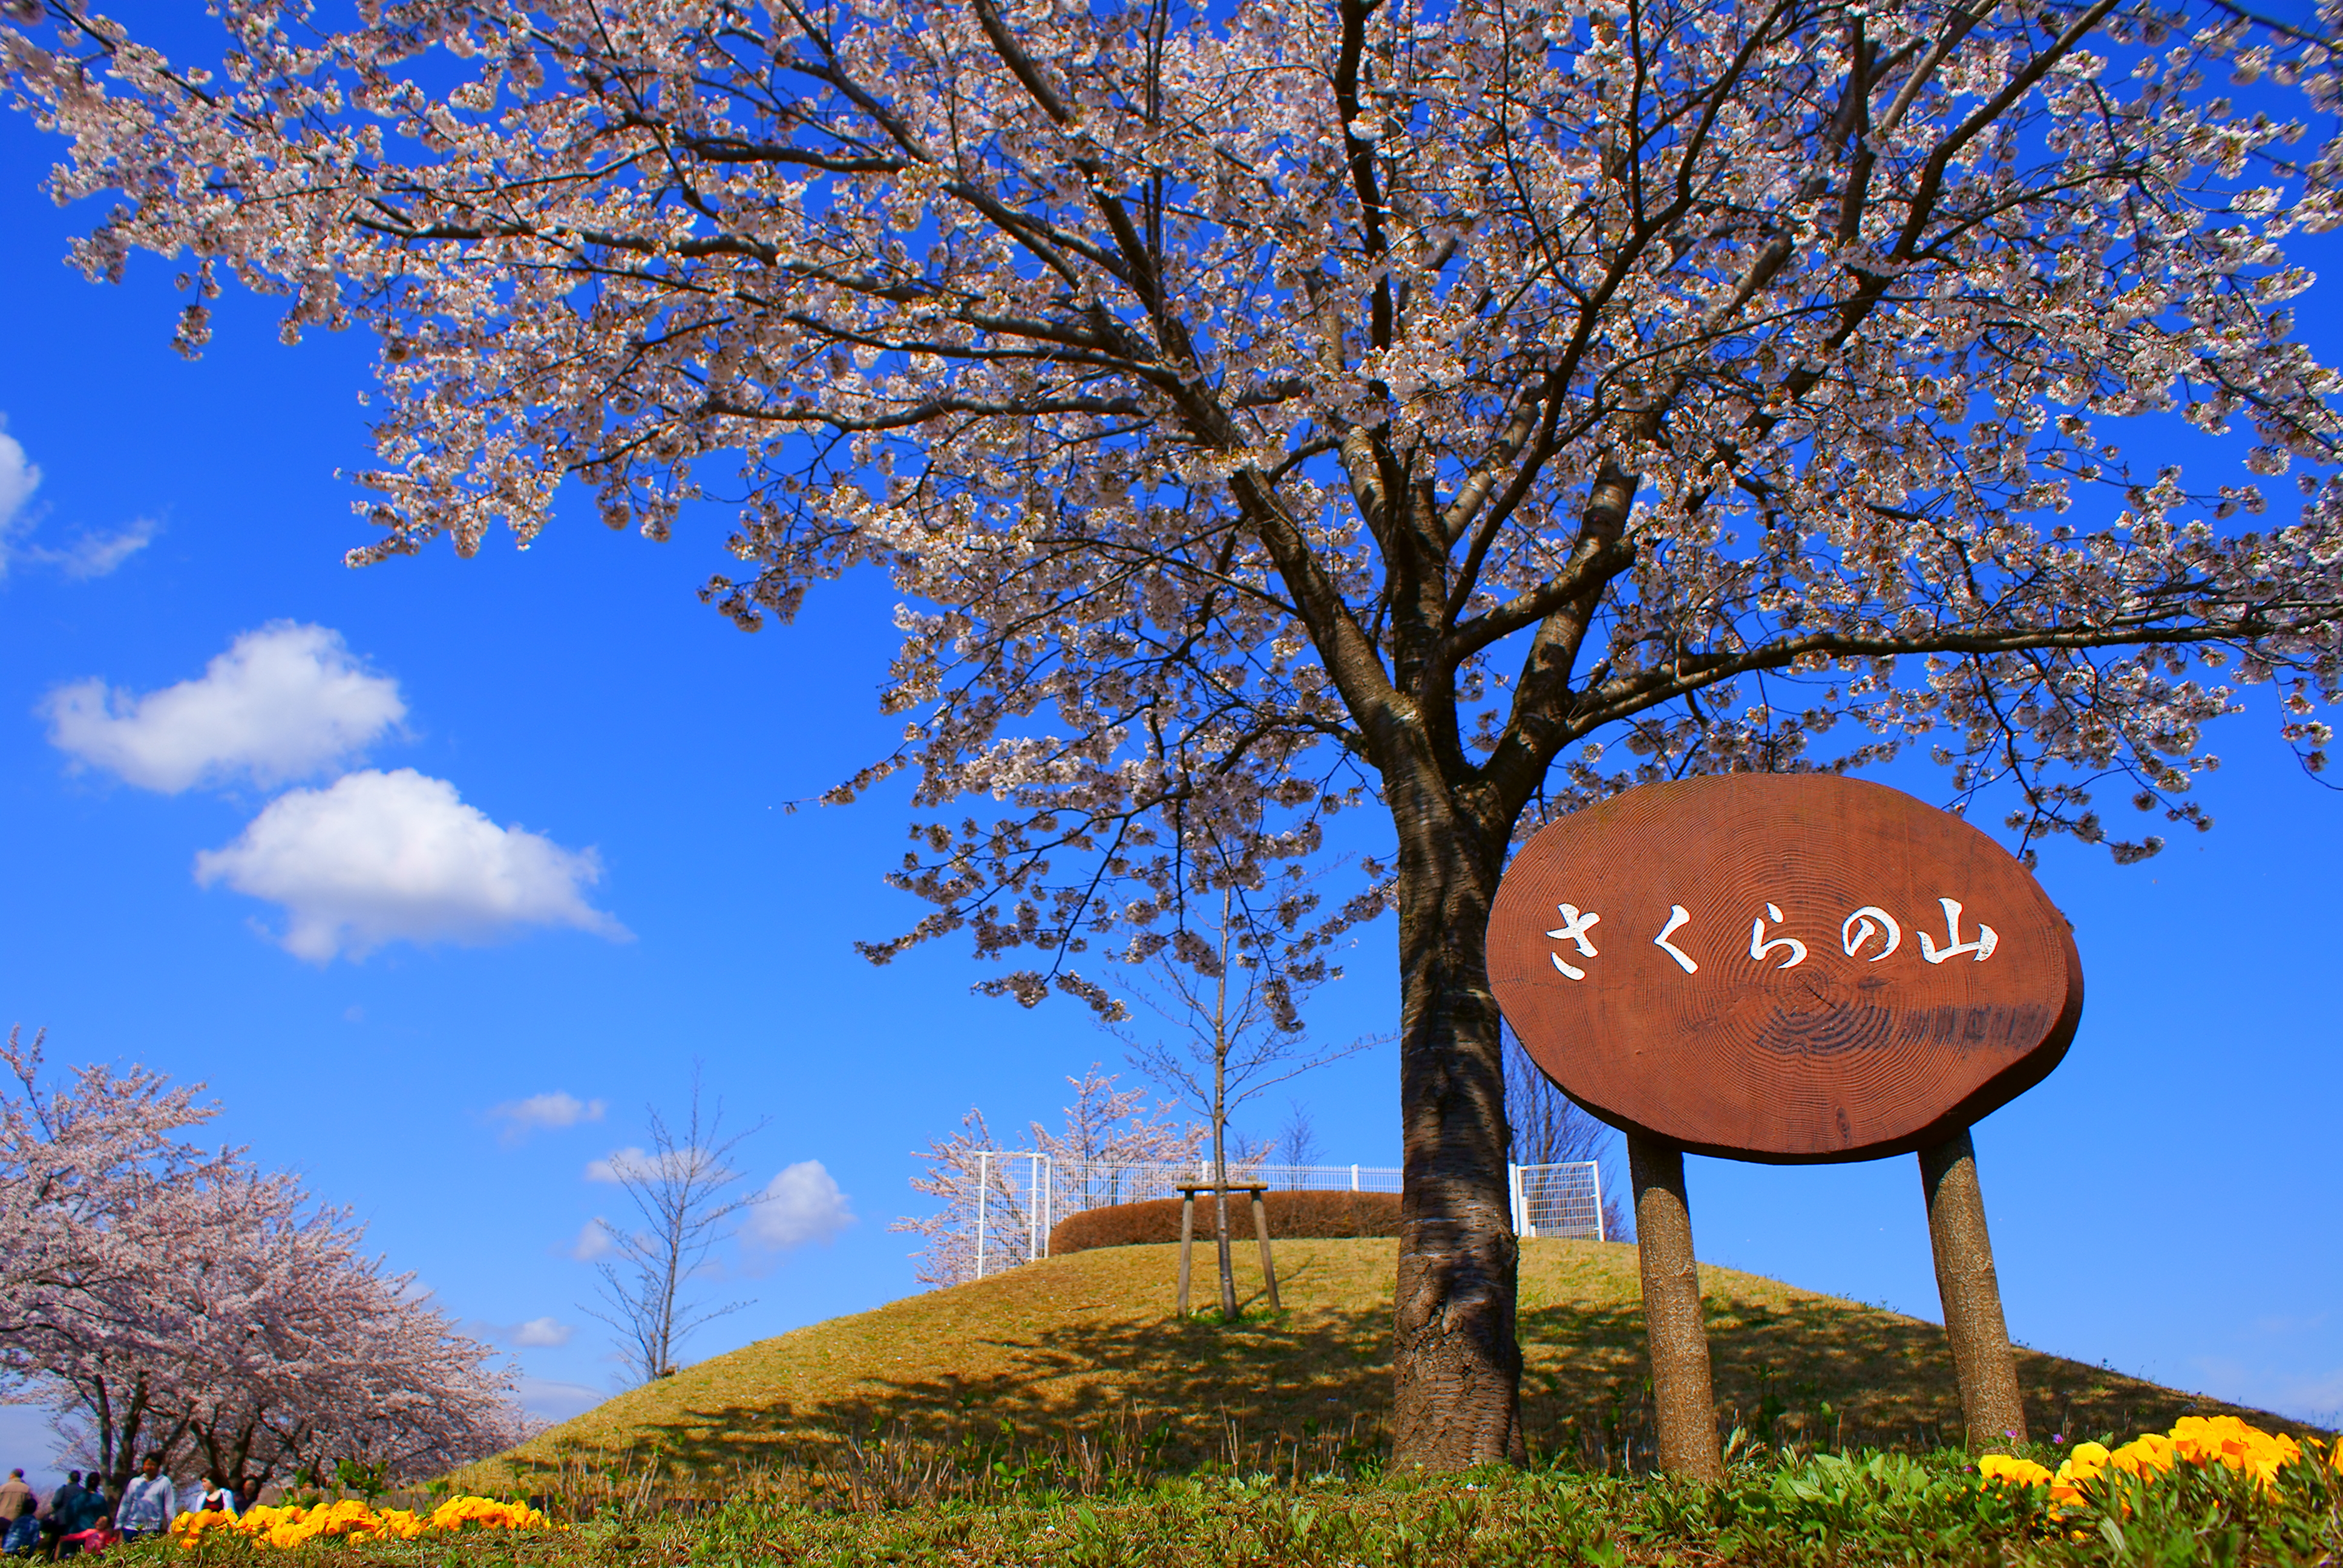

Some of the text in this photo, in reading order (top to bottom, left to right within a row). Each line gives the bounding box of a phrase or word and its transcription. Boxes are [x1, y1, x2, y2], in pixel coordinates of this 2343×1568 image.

[1545, 897, 1999, 981] さくらの山
